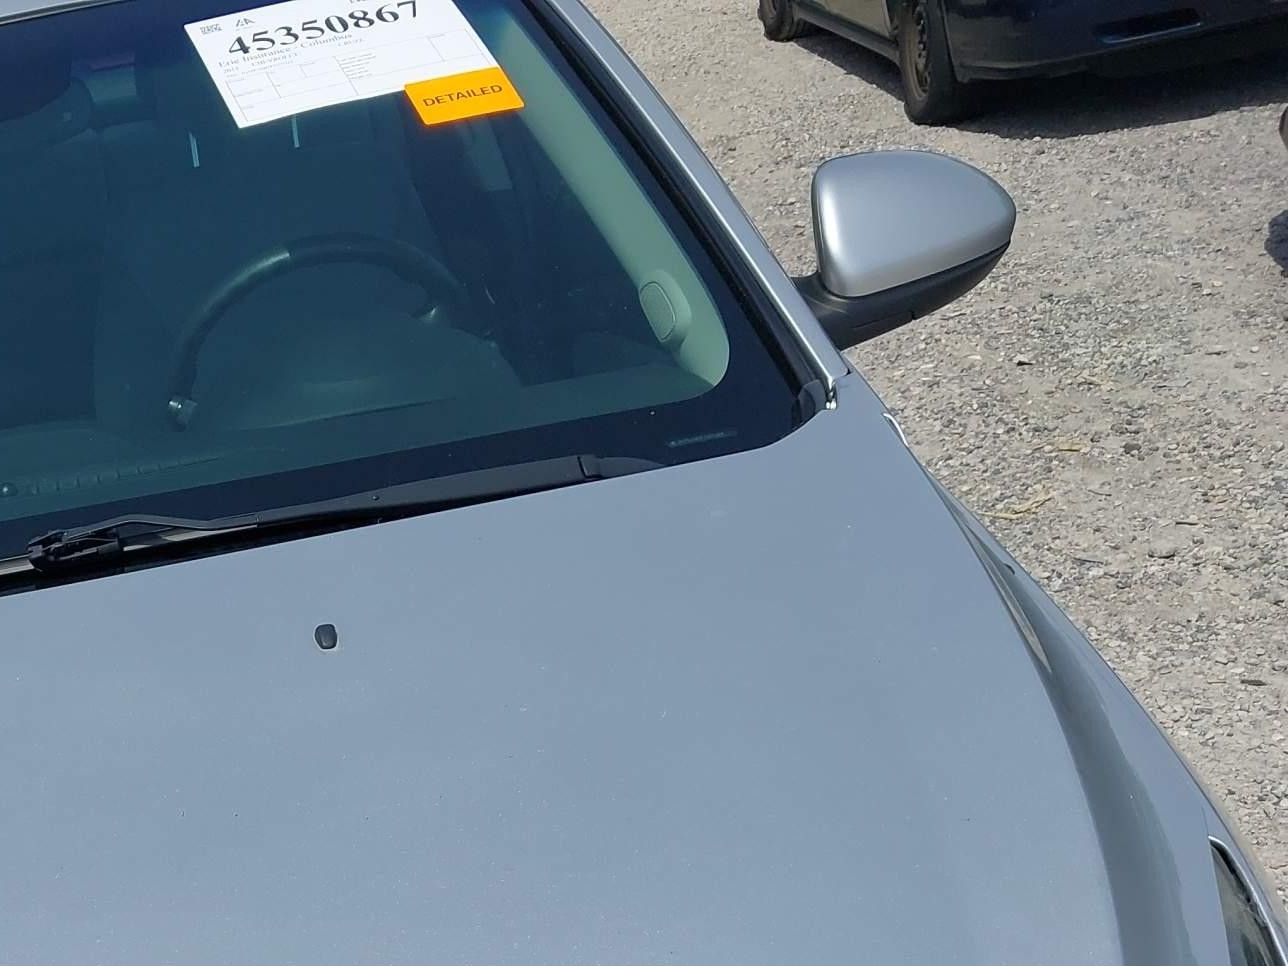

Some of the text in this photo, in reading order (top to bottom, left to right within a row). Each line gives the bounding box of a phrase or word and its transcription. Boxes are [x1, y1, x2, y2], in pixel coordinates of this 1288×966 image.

[229, 0, 417, 55] 45350867
[300, 33, 353, 49] Columbus
[423, 84, 503, 107] DETAILED
